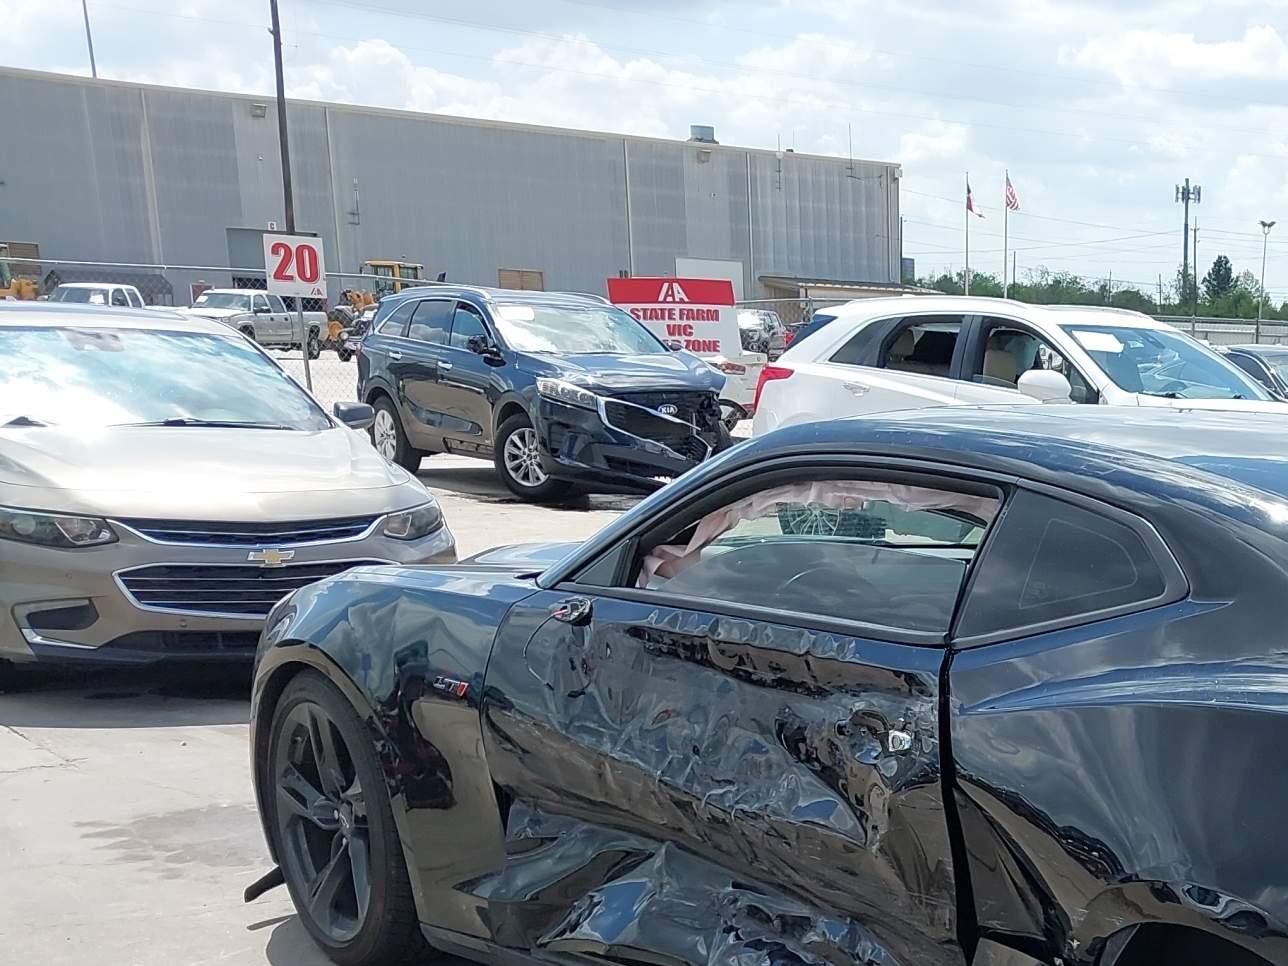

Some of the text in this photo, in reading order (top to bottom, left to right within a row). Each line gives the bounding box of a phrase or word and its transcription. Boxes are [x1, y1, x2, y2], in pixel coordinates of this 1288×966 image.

[271, 242, 319, 283] 20
[630, 308, 720, 322] STATE FARM
[666, 324, 694, 337] VIC
[684, 339, 721, 352] ZONE
